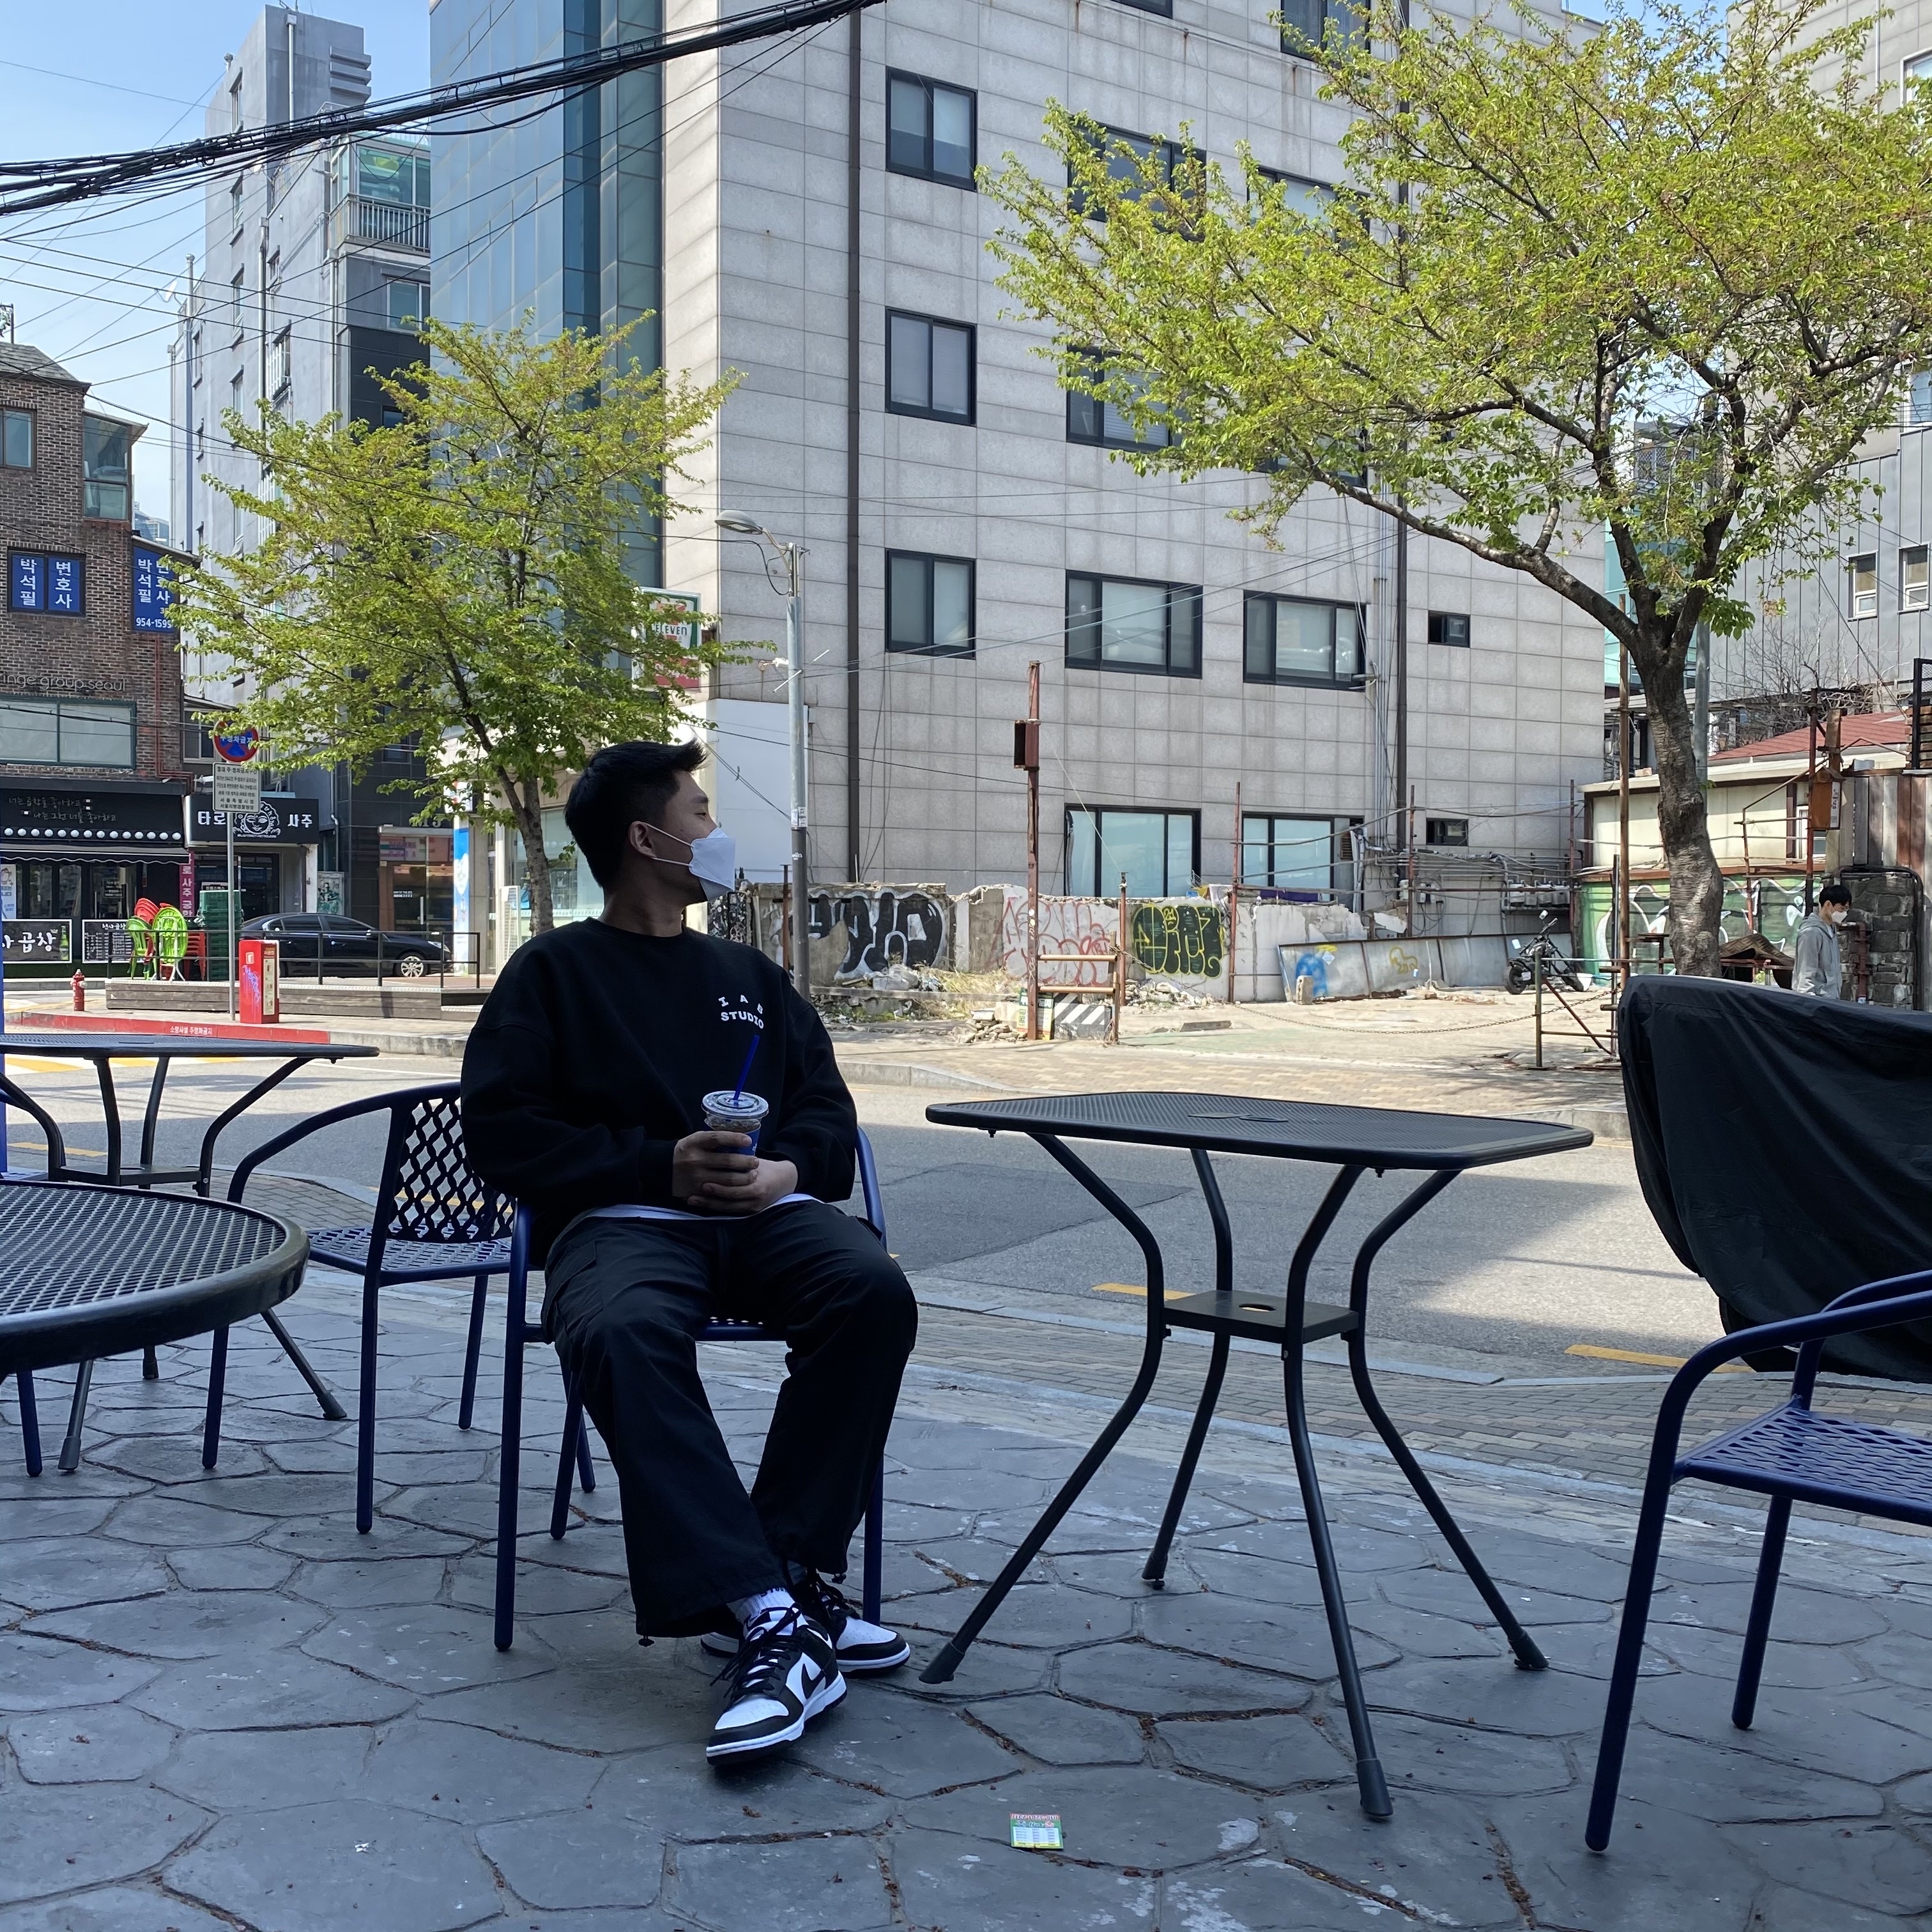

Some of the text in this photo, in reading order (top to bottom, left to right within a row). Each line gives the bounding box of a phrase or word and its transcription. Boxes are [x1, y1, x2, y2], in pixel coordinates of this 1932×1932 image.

[20, 558, 37, 606] 박석필
[55, 561, 72, 609] 변호사
[137, 558, 152, 604] 박석필
[50, 797, 81, 809] 좋아하고
[87, 812, 117, 824] 좋아하고
[197, 811, 312, 828] 타로 사주
[721, 1011, 764, 1029] STUDIO
